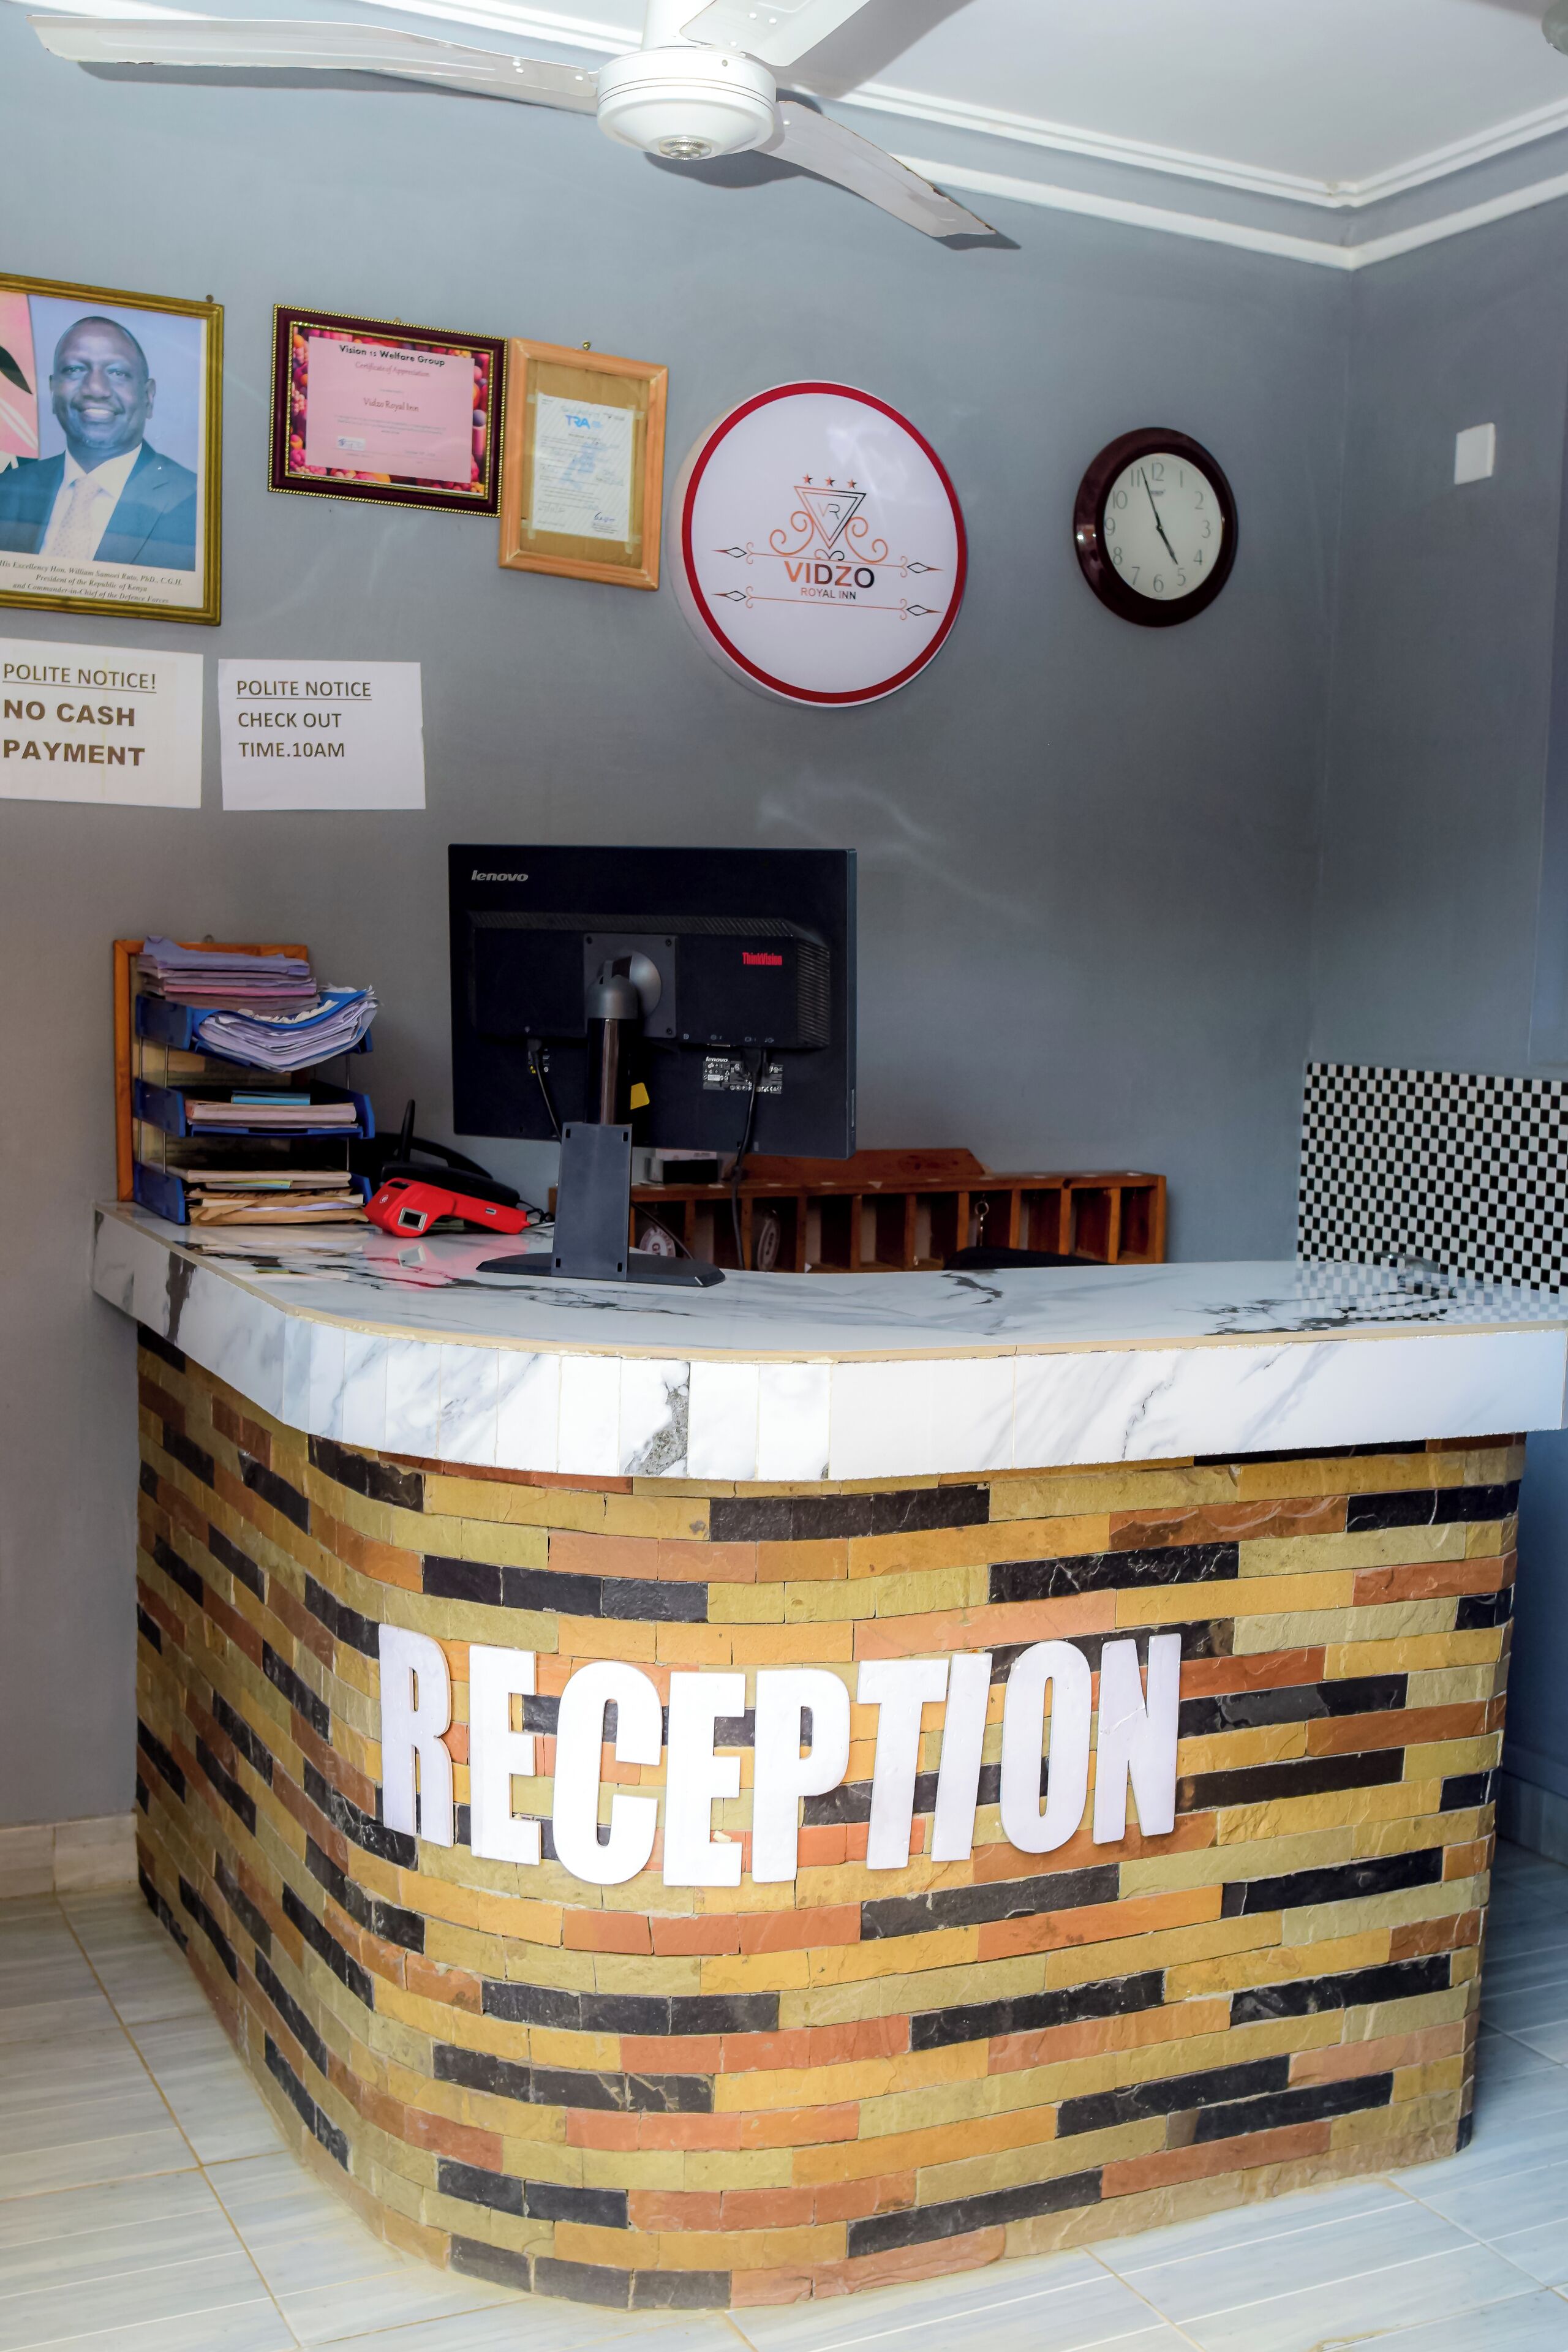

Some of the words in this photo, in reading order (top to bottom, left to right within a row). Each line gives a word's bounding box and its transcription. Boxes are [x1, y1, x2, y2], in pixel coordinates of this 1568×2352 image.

[339, 345, 367, 355] Vision
[380, 350, 415, 362] Welfare
[418, 355, 445, 367] Group
[385, 401, 405, 412] Royal
[406, 403, 419, 412] Inn
[565, 415, 590, 429] TRA
[1131, 470, 1140, 487] 11
[1151, 462, 1164, 481] 12
[1180, 470, 1183, 488] 1
[1112, 491, 1128, 510] 10
[1194, 491, 1204, 510] 2
[817, 502, 840, 520] VR
[1105, 517, 1116, 536] 9
[1201, 519, 1211, 538] 3
[1112, 546, 1123, 565] 8
[1193, 549, 1203, 565] 4
[13, 562, 48, 572] Excellency
[69, 567, 94, 576] William
[783, 560, 875, 589] VIDZO
[1131, 567, 1140, 586] 7
[1177, 567, 1186, 586] 5
[36, 574, 67, 584] President
[89, 579, 116, 589] Republic
[127, 583, 147, 593] Kenya
[1153, 573, 1164, 593] 6
[119, 592, 146, 601] Defence
[801, 587, 835, 598] ROYAL
[839, 590, 856, 600] INN
[4, 663, 70, 682] POLITE
[78, 669, 156, 689] NOTICE!
[237, 680, 299, 696] POLITE
[306, 681, 371, 696] NOTICE
[4, 699, 45, 720] NO
[56, 703, 135, 726] CASH
[238, 712, 298, 728] CHECK
[303, 713, 342, 728] OUT
[4, 739, 145, 766] PAYMENT
[238, 742, 345, 757] TIME.10AM
[471, 870, 529, 881] lenovo
[742, 952, 782, 965] ThinkVision
[378, 1623, 1182, 1887] RECEPTION
